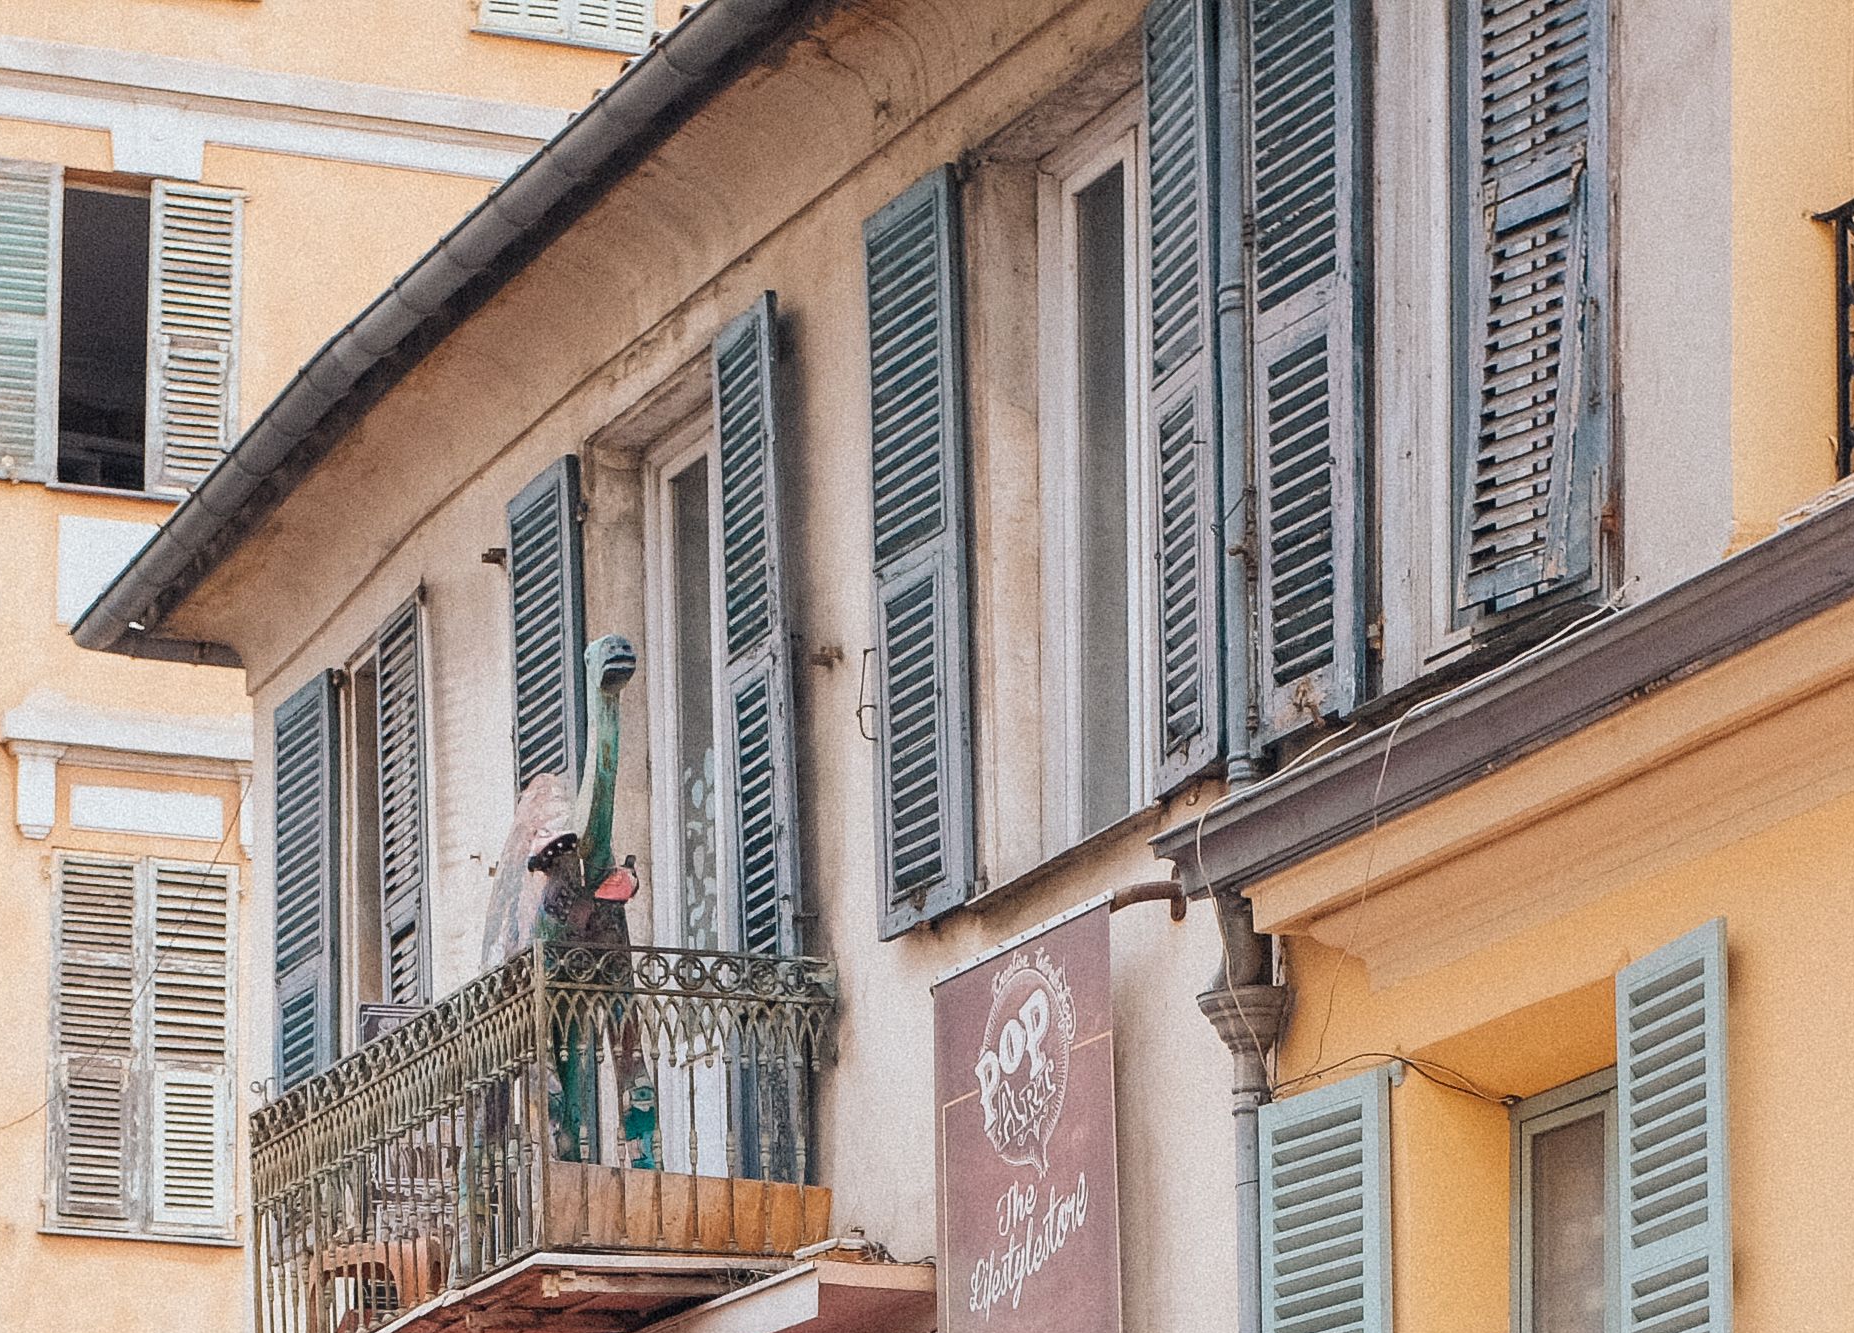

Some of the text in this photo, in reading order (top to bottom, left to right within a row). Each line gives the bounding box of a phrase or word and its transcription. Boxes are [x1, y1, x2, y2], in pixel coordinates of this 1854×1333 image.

[974, 987, 1050, 1135] POP
[996, 1059, 1056, 1152] ART
[969, 1171, 1090, 1323] Lifestylestore
[995, 1180, 1039, 1237] The
